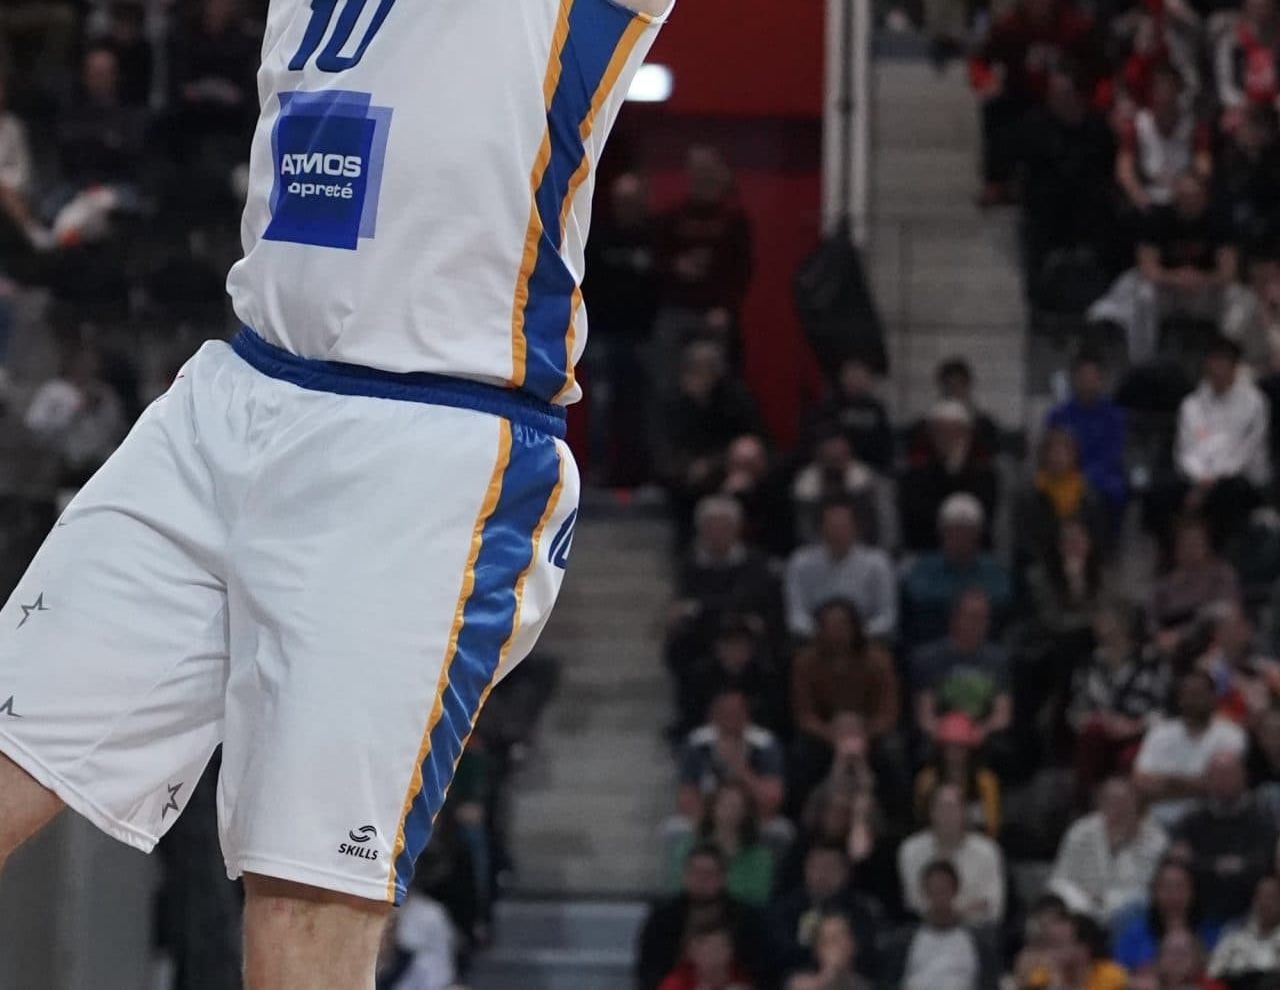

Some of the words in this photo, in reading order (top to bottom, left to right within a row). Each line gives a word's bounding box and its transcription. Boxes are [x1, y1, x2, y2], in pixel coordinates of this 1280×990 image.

[280, 152, 362, 178] ATMOS
[287, 182, 354, 199] opreté
[337, 843, 379, 861] SKILLS
